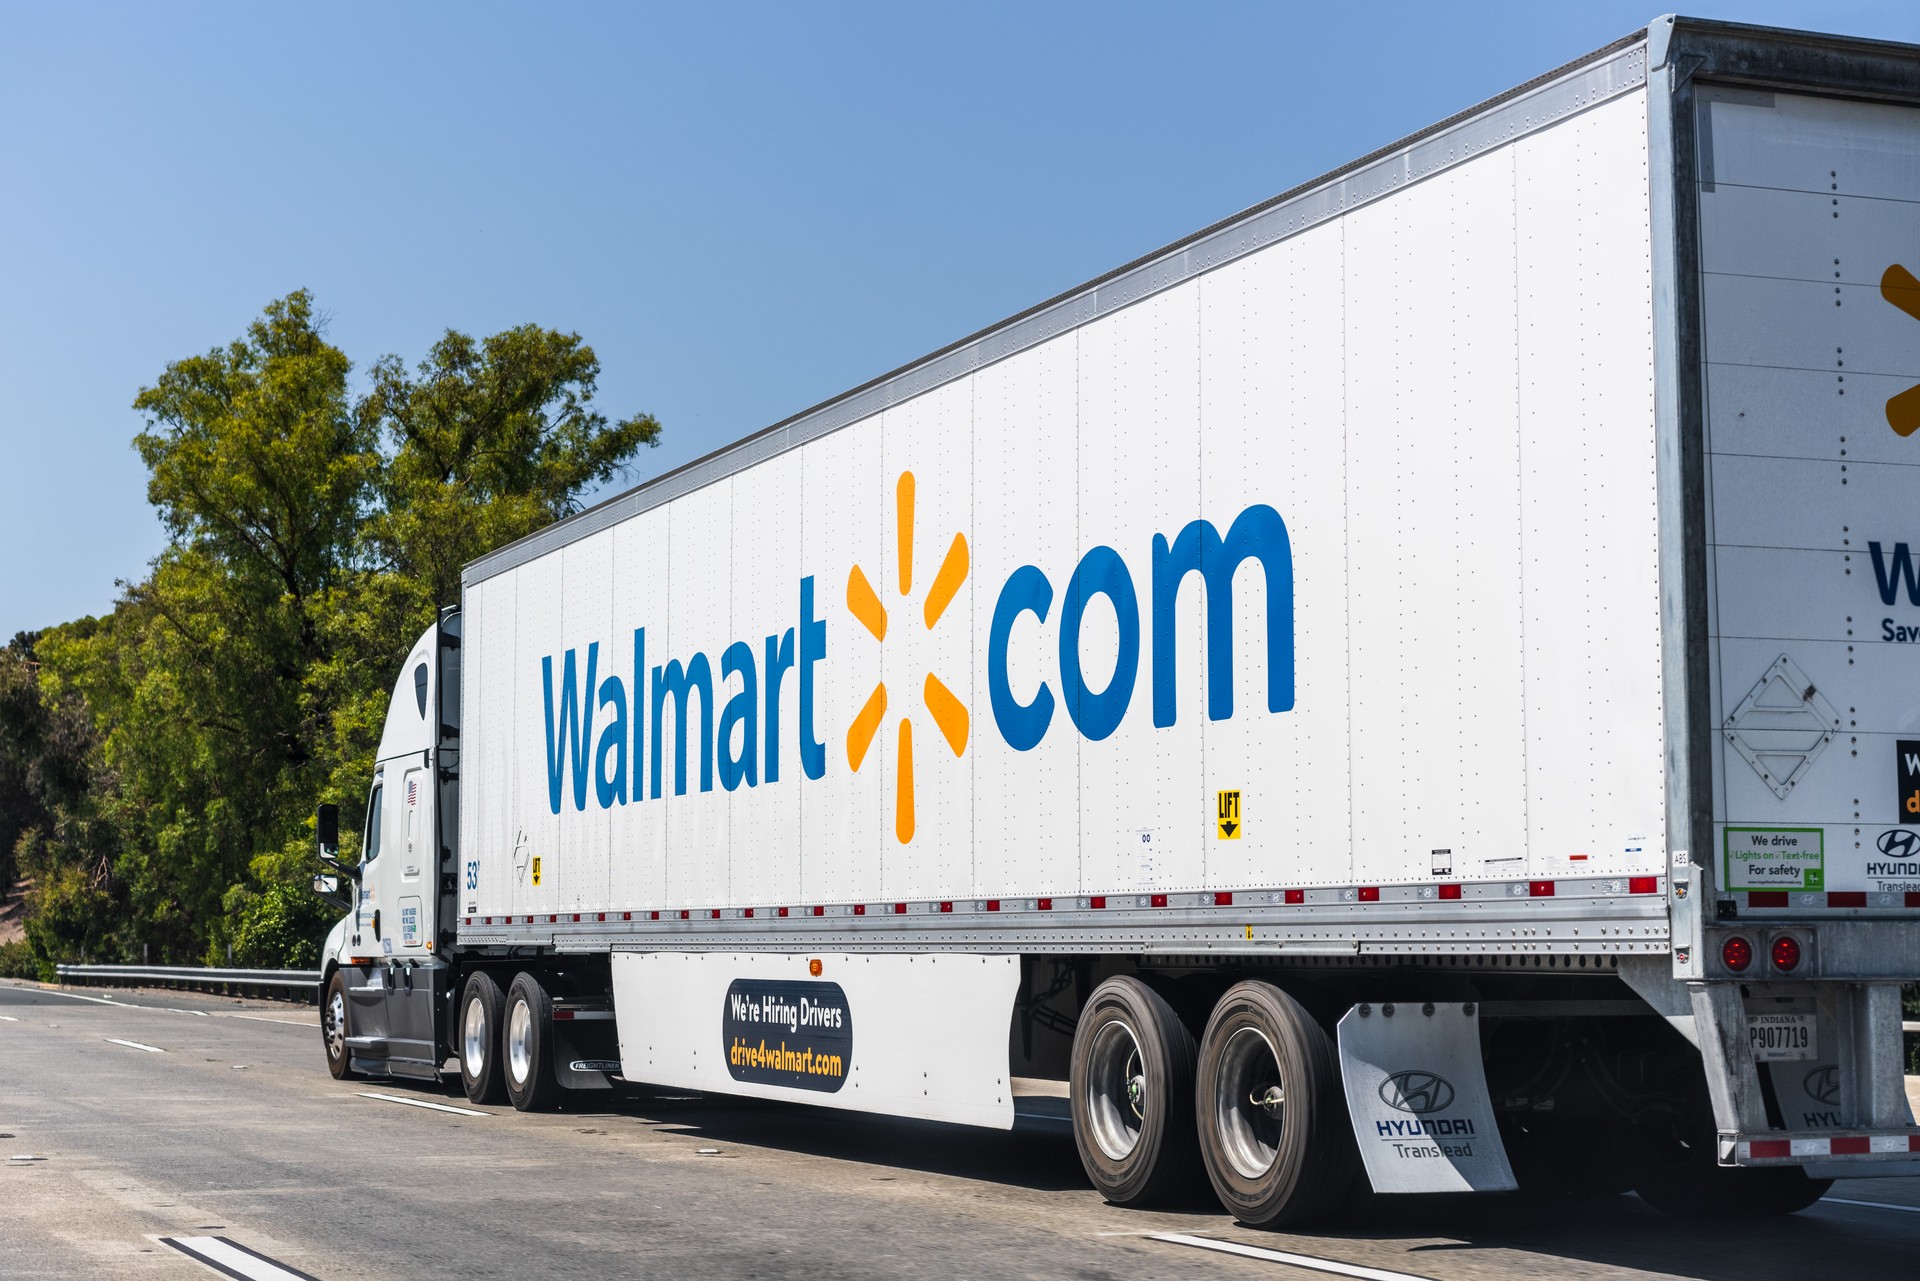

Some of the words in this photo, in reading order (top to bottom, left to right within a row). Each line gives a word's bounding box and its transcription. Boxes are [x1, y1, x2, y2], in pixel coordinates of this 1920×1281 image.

[1881, 618, 1920, 643] Sav
[542, 575, 827, 814] Walmart
[988, 504, 1296, 752] com
[1218, 792, 1240, 819] LIFT
[1751, 835, 1768, 846] We
[1771, 835, 1798, 846] drive
[1674, 853, 1687, 864] ABS
[1735, 850, 1761, 861] Lights
[1781, 850, 1820, 860] Text-free
[1748, 864, 1766, 875] For
[1768, 864, 1800, 878] safety
[1867, 863, 1920, 876] HYUND
[730, 993, 760, 1022] We're
[762, 996, 798, 1033] Hiring
[800, 997, 842, 1029] Drivers
[1760, 1016, 1797, 1024] INDIANA
[1749, 1027, 1808, 1049] P907719
[730, 1036, 842, 1077] drive4walmart.com
[1376, 1119, 1475, 1136] HYUNDAI
[1393, 1142, 1473, 1158] Translead
